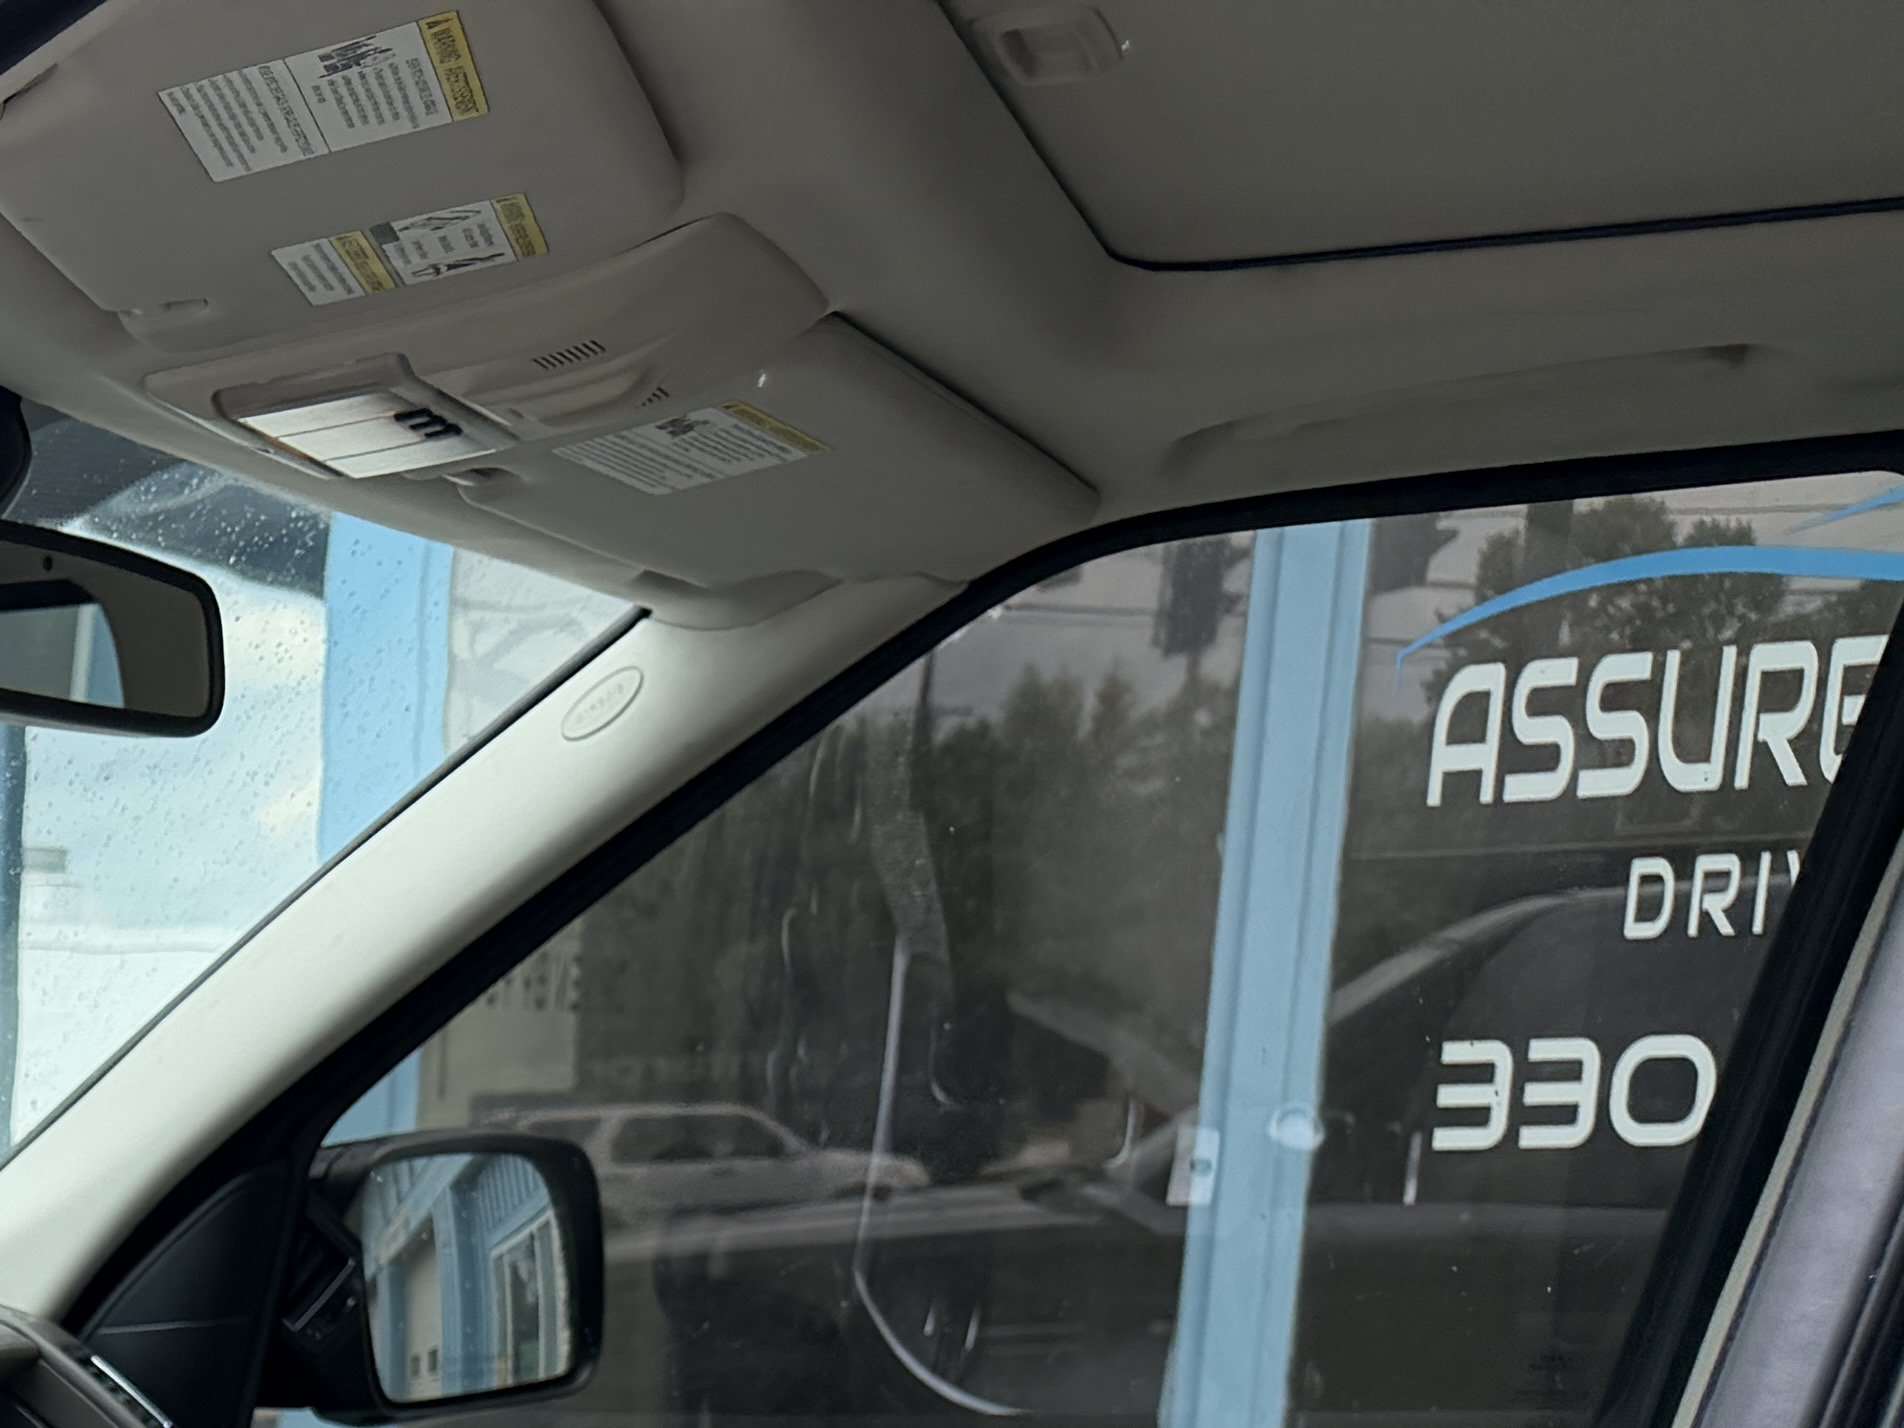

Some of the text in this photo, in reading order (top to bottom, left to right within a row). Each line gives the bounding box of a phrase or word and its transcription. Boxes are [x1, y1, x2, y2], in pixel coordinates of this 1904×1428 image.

[1426, 634, 1889, 807] ASSURE
[1623, 850, 1800, 940] DRI
[1431, 1033, 1717, 1151] 330
